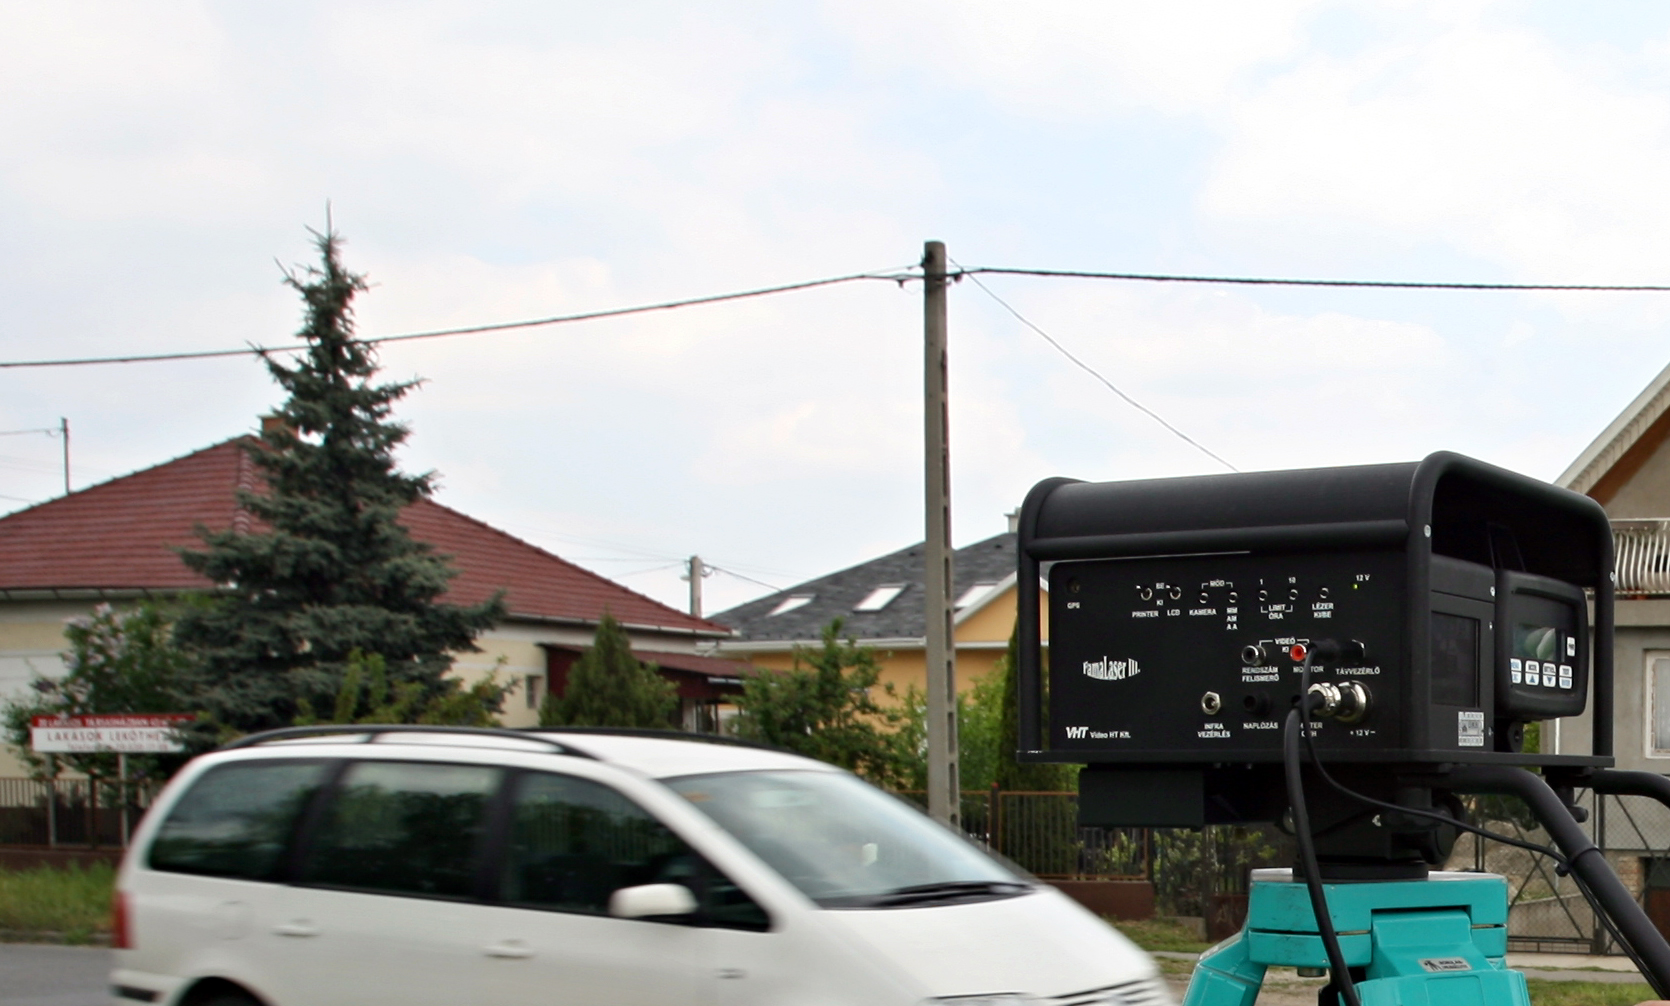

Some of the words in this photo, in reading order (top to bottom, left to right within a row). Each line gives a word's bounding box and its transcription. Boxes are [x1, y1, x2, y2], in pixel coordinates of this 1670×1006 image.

[1311, 602, 1334, 610] LÉZER
[1167, 609, 1181, 617] LCD
[1189, 609, 1217, 617] KAMERA
[1241, 666, 1279, 674] RENDSZÁM
[1204, 722, 1224, 730] INFRA
[1243, 722, 1279, 730] NAPLÓZÁS
[1065, 726, 1089, 739] VHT
[1109, 731, 1118, 739] HT
[1197, 730, 1231, 738] VEZÉRLÉS
